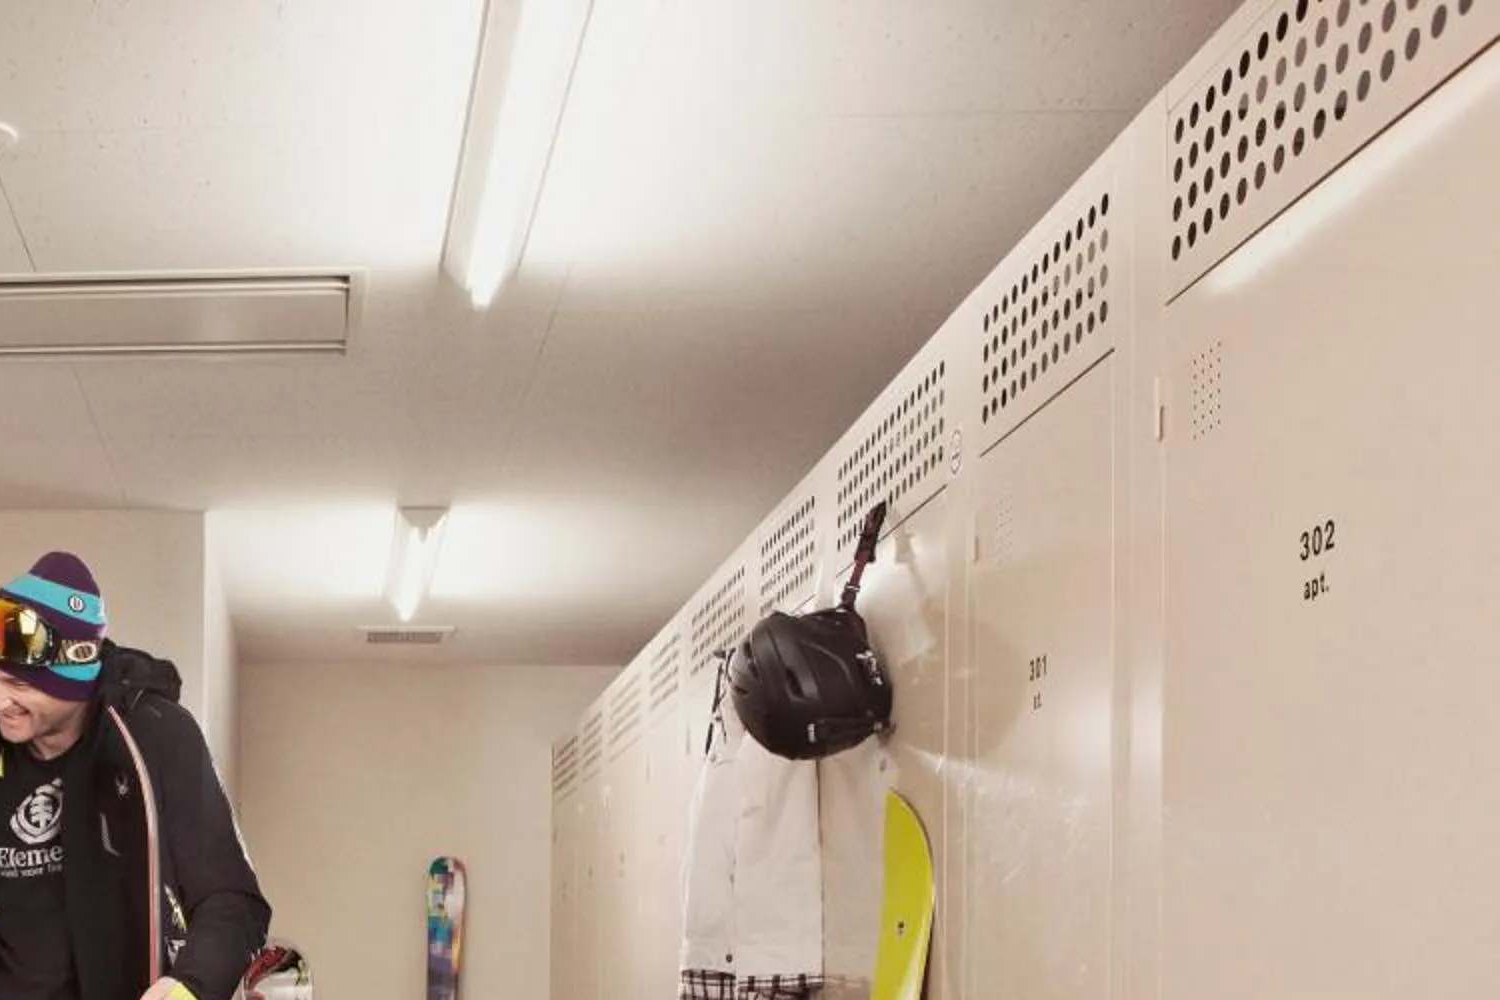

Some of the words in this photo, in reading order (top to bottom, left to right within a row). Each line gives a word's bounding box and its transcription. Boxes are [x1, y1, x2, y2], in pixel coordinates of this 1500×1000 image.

[1299, 519, 1336, 562] 302
[1303, 572, 1330, 601] apt.
[1029, 654, 1048, 681] 301
